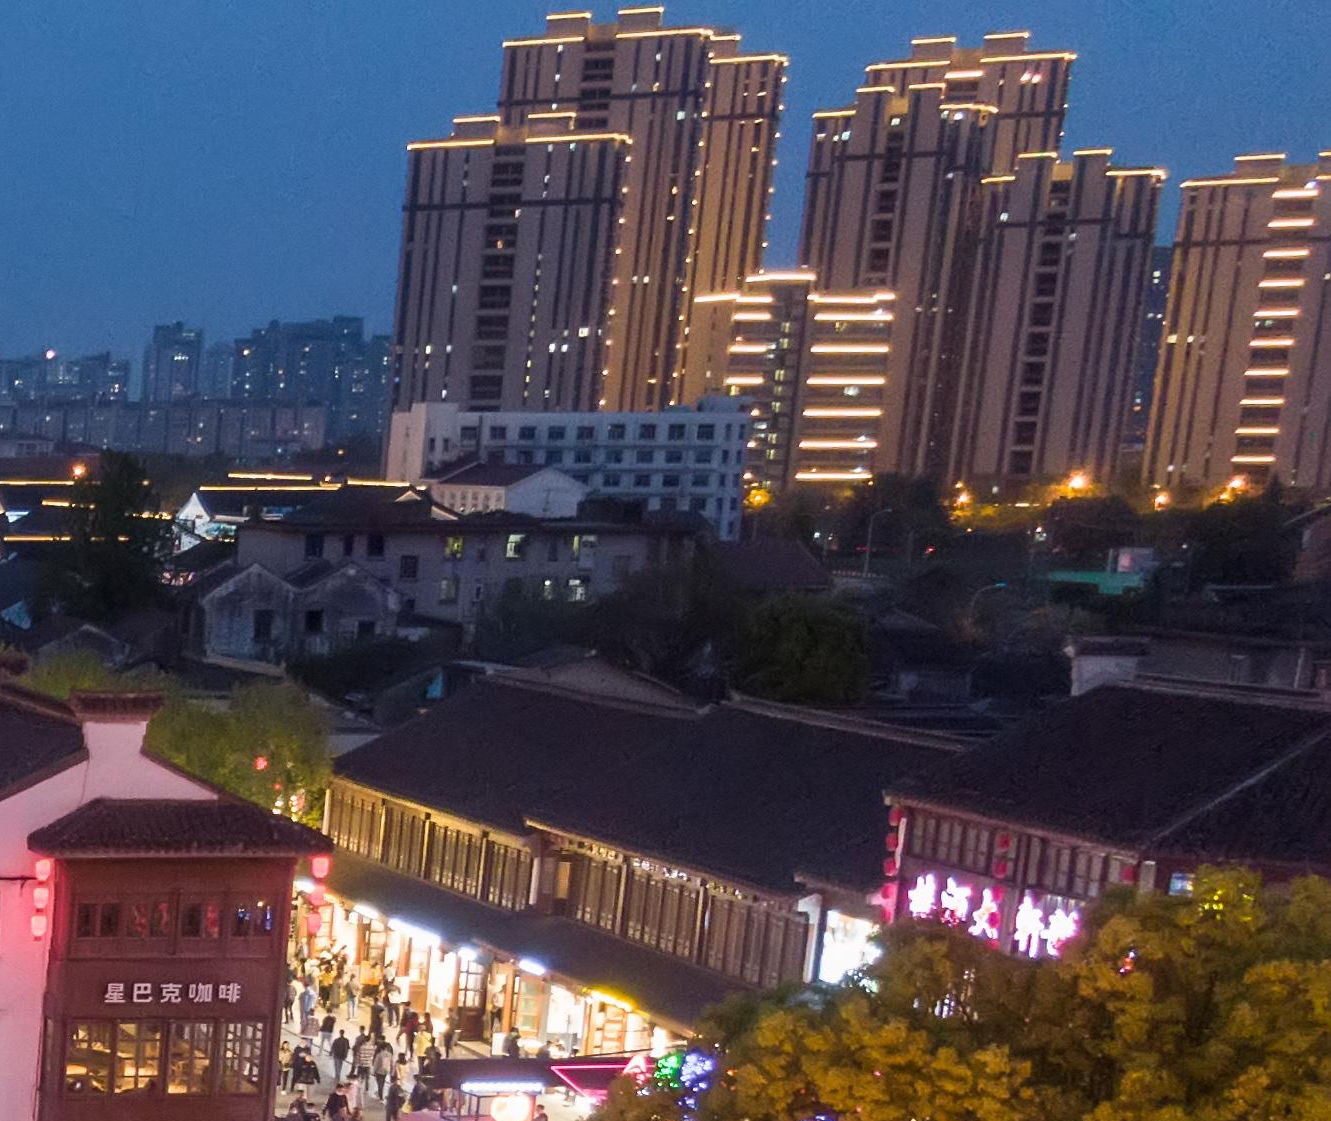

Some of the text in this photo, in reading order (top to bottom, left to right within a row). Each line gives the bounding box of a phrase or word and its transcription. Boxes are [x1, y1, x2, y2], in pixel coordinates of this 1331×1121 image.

[104, 982, 242, 1003] 星巴克咖啡
